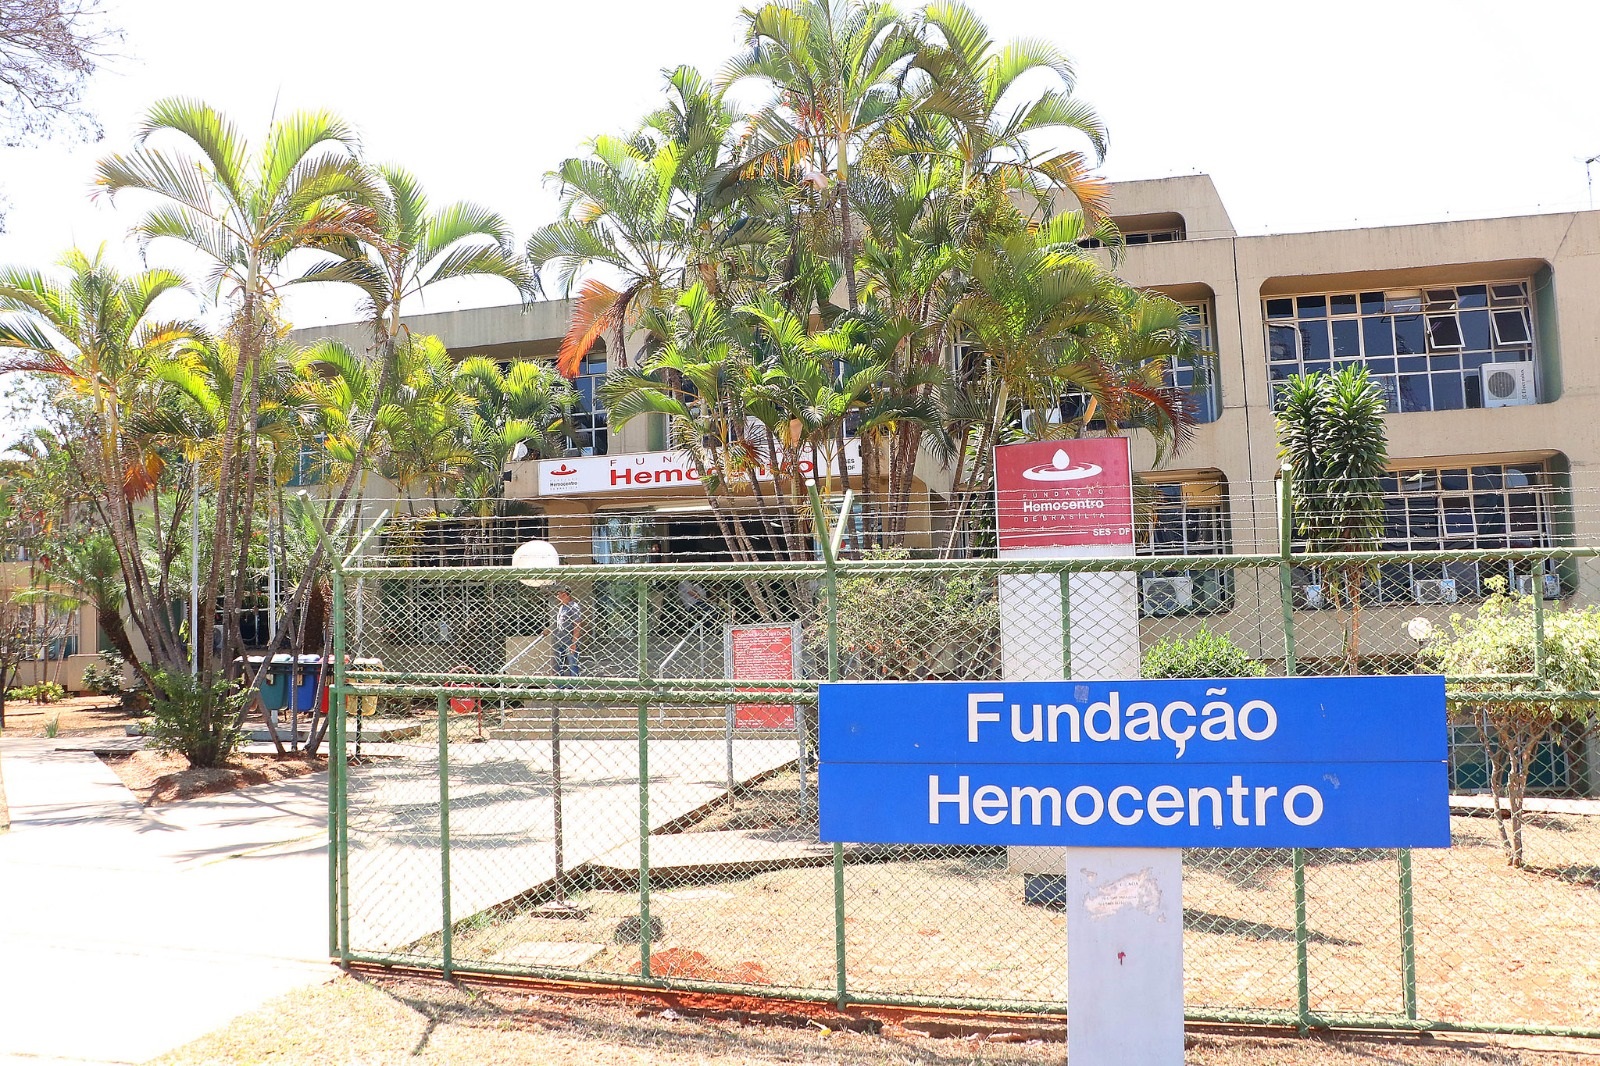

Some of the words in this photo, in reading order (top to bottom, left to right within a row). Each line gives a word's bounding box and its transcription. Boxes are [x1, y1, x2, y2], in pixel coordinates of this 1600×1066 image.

[1023, 499, 1104, 513] Hemocentro
[967, 687, 1278, 760] Fundação
[928, 775, 1324, 827] Hemocentro
